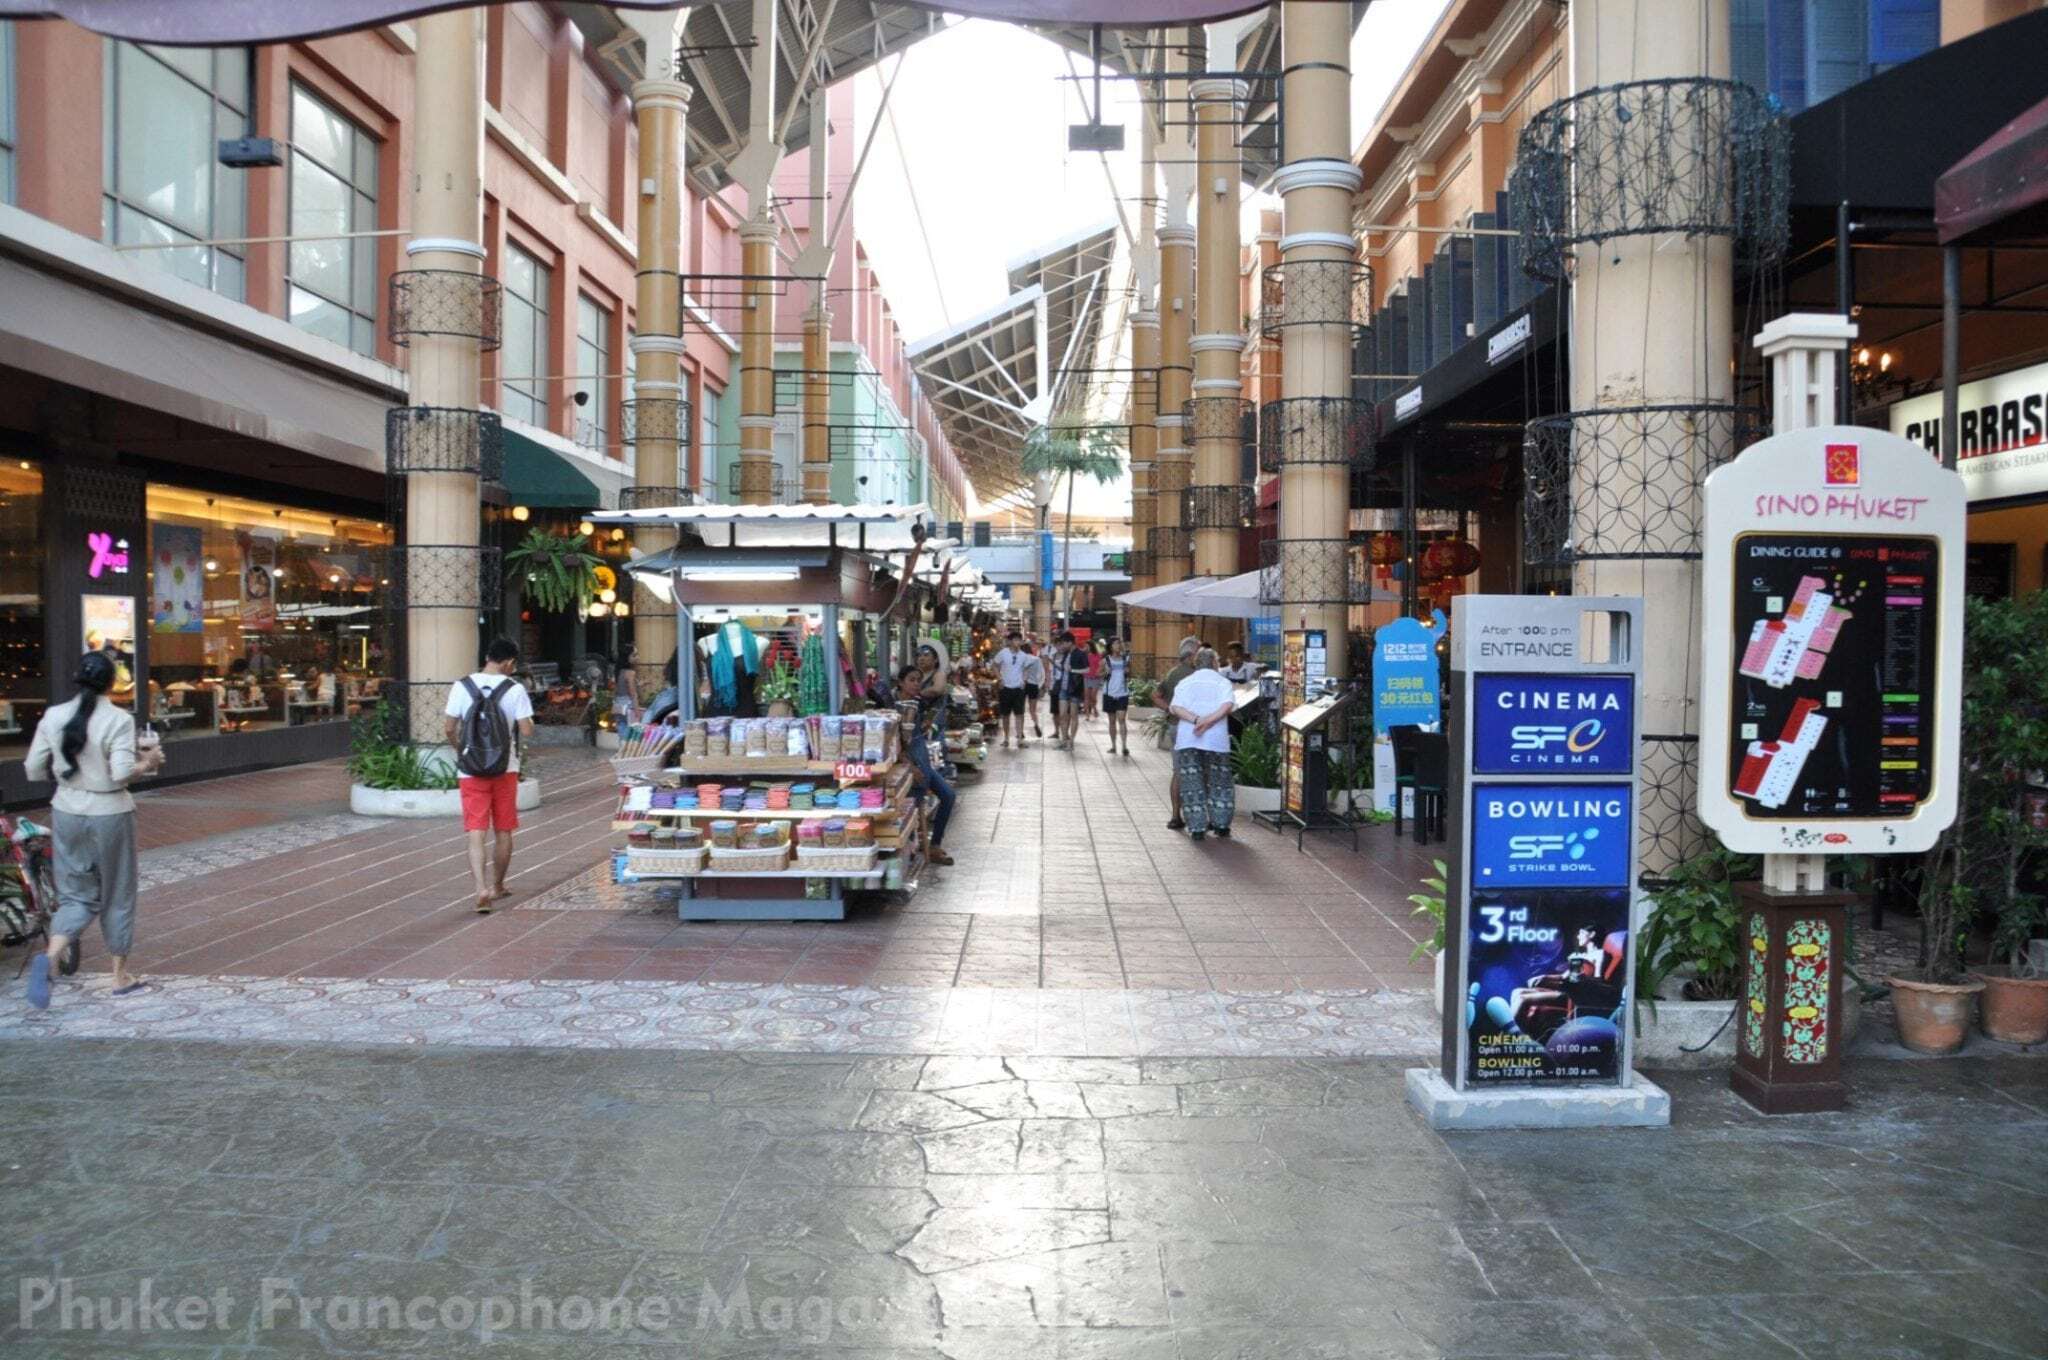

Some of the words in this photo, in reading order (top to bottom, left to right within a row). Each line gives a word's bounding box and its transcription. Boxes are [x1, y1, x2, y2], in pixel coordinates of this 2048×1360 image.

[1906, 394, 2048, 464] HRRAS
[1756, 494, 1819, 517] SINO
[1825, 494, 1929, 521] PHUKET
[1750, 546, 1792, 558] DINING
[1794, 547, 1828, 559] GUIDE
[1481, 642, 1573, 657] ENTRANCE
[1497, 691, 1620, 711] CINEMA
[1510, 754, 1600, 764] CINEMA
[1488, 800, 1622, 819] BOWLING
[1508, 863, 1556, 873] STRIKE
[1561, 863, 1597, 872] BOWL
[1507, 925, 1559, 943] Floor
[1478, 1034, 1533, 1046] CINEMA
[1478, 1046, 1502, 1055] Open
[1503, 1045, 1526, 1054] 11.00
[1478, 1057, 1542, 1069] BOWLING
[1477, 1069, 1500, 1079] Open
[1502, 1068, 1525, 1077] 12.00
